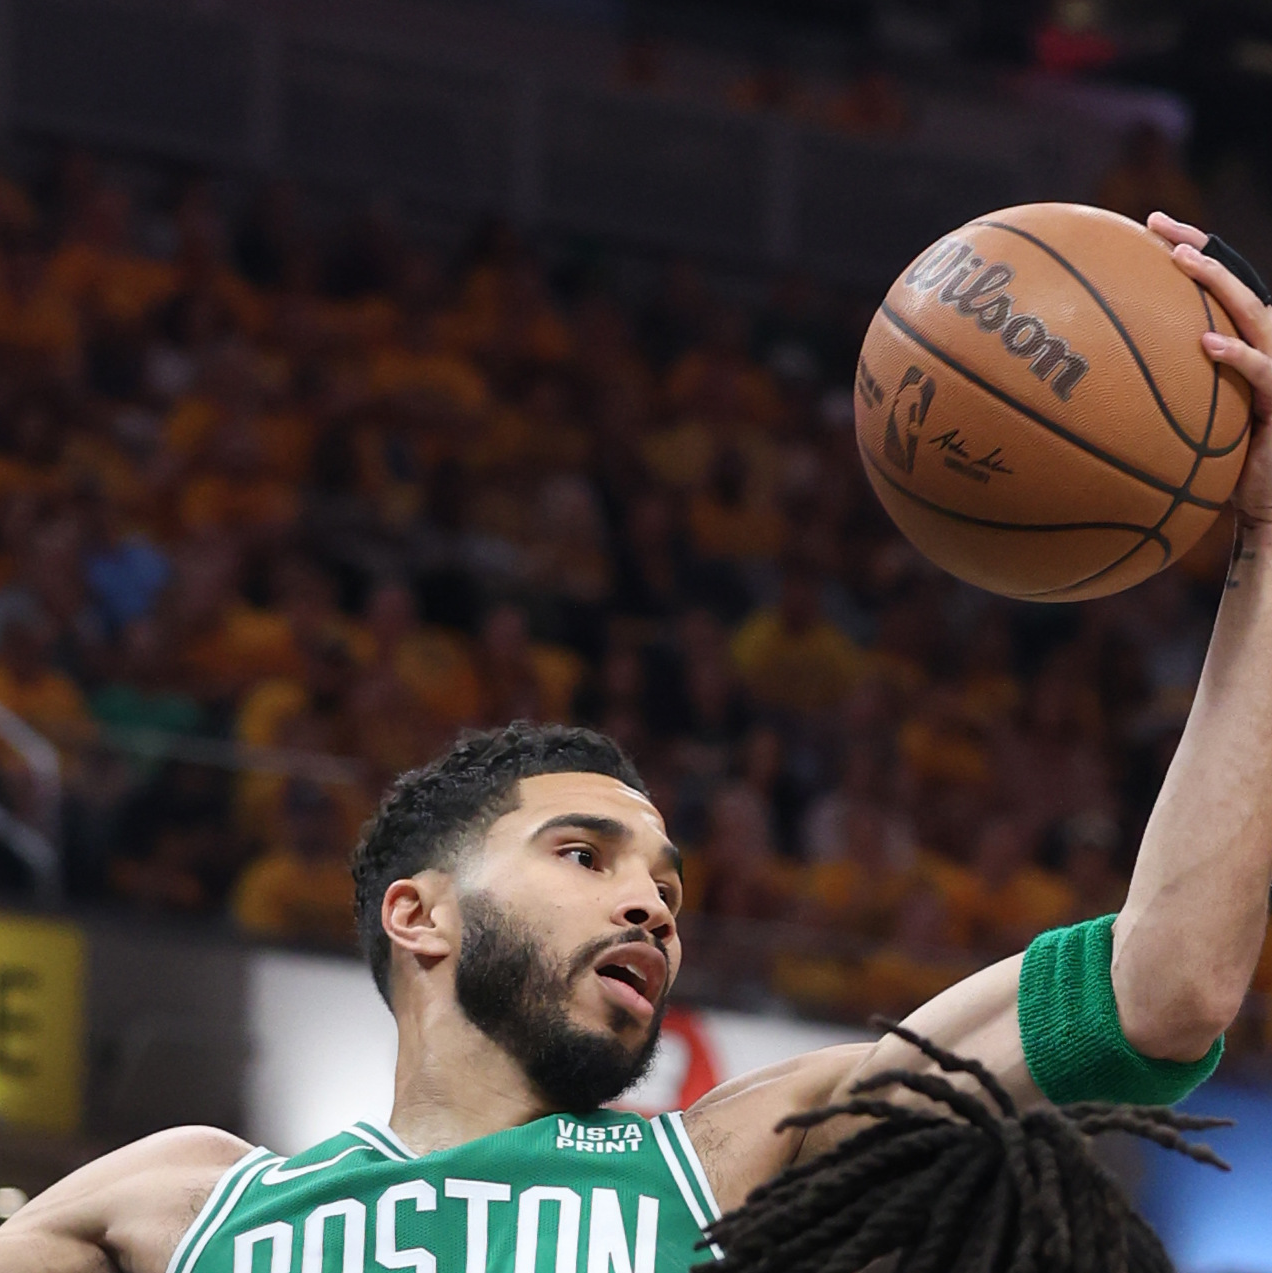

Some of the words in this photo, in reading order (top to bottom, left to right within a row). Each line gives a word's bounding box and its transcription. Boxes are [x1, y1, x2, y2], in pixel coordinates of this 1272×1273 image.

[904, 236, 1090, 402] Wilson
[557, 1118, 642, 1141] VISTA
[556, 1135, 643, 1153] PRINT
